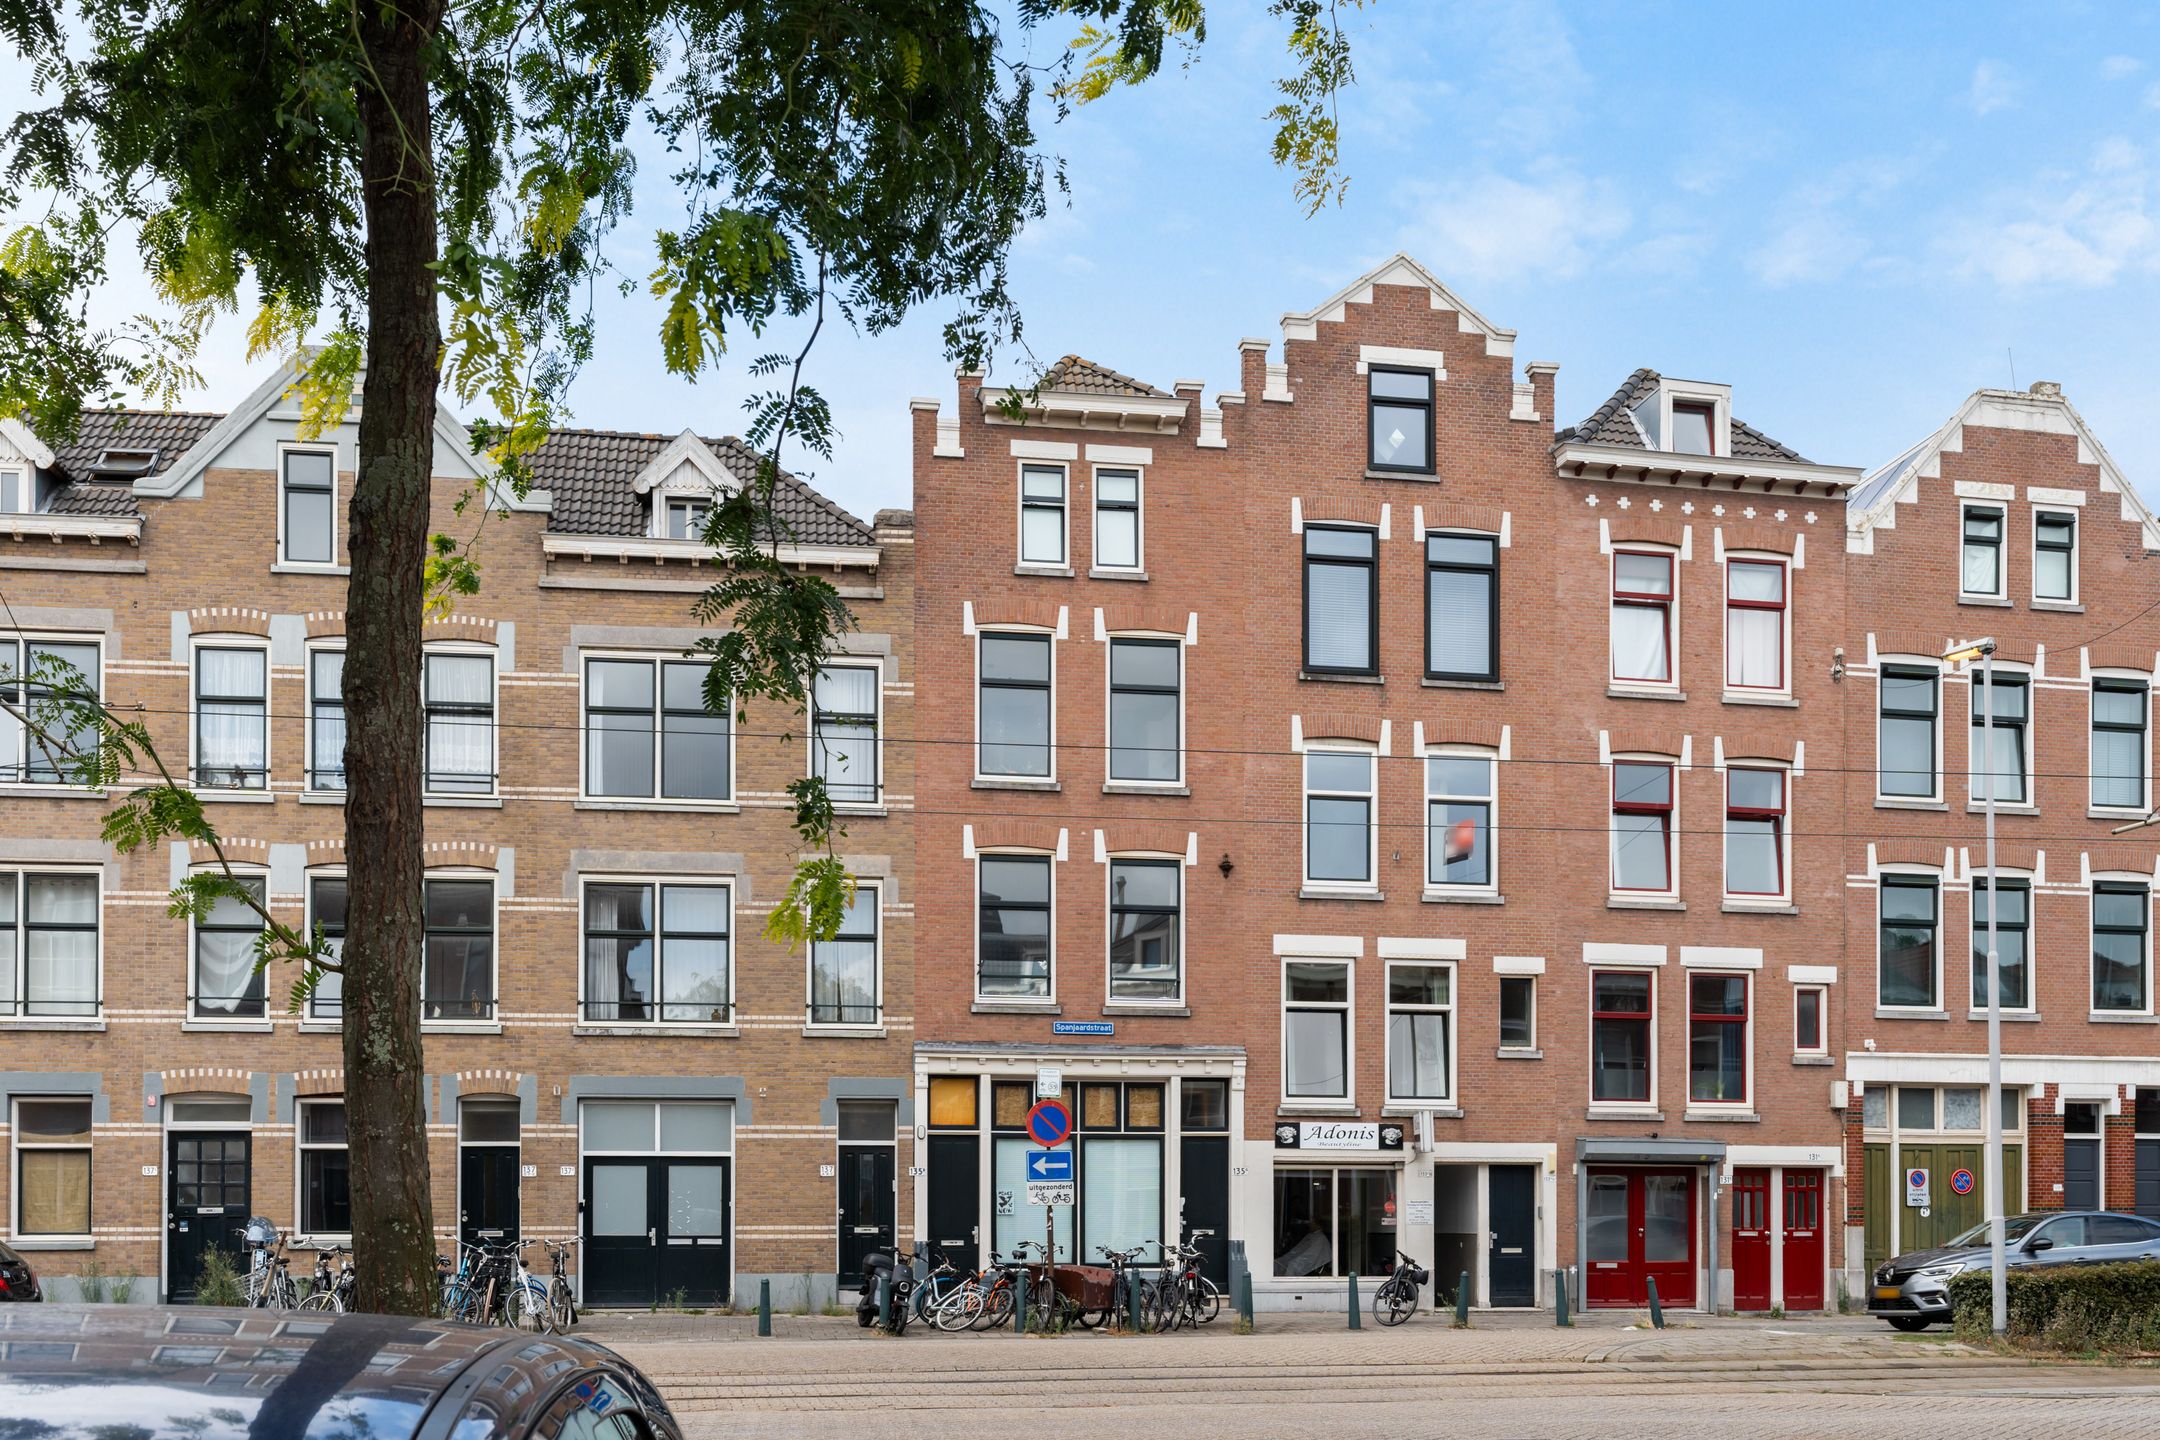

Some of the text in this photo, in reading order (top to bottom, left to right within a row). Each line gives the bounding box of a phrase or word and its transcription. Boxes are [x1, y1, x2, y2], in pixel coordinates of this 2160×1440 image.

[1055, 1023, 1111, 1033] Spanjaardstraat
[1304, 1124, 1375, 1141] Adonis
[1028, 1184, 1073, 1192] uitgezonderd
